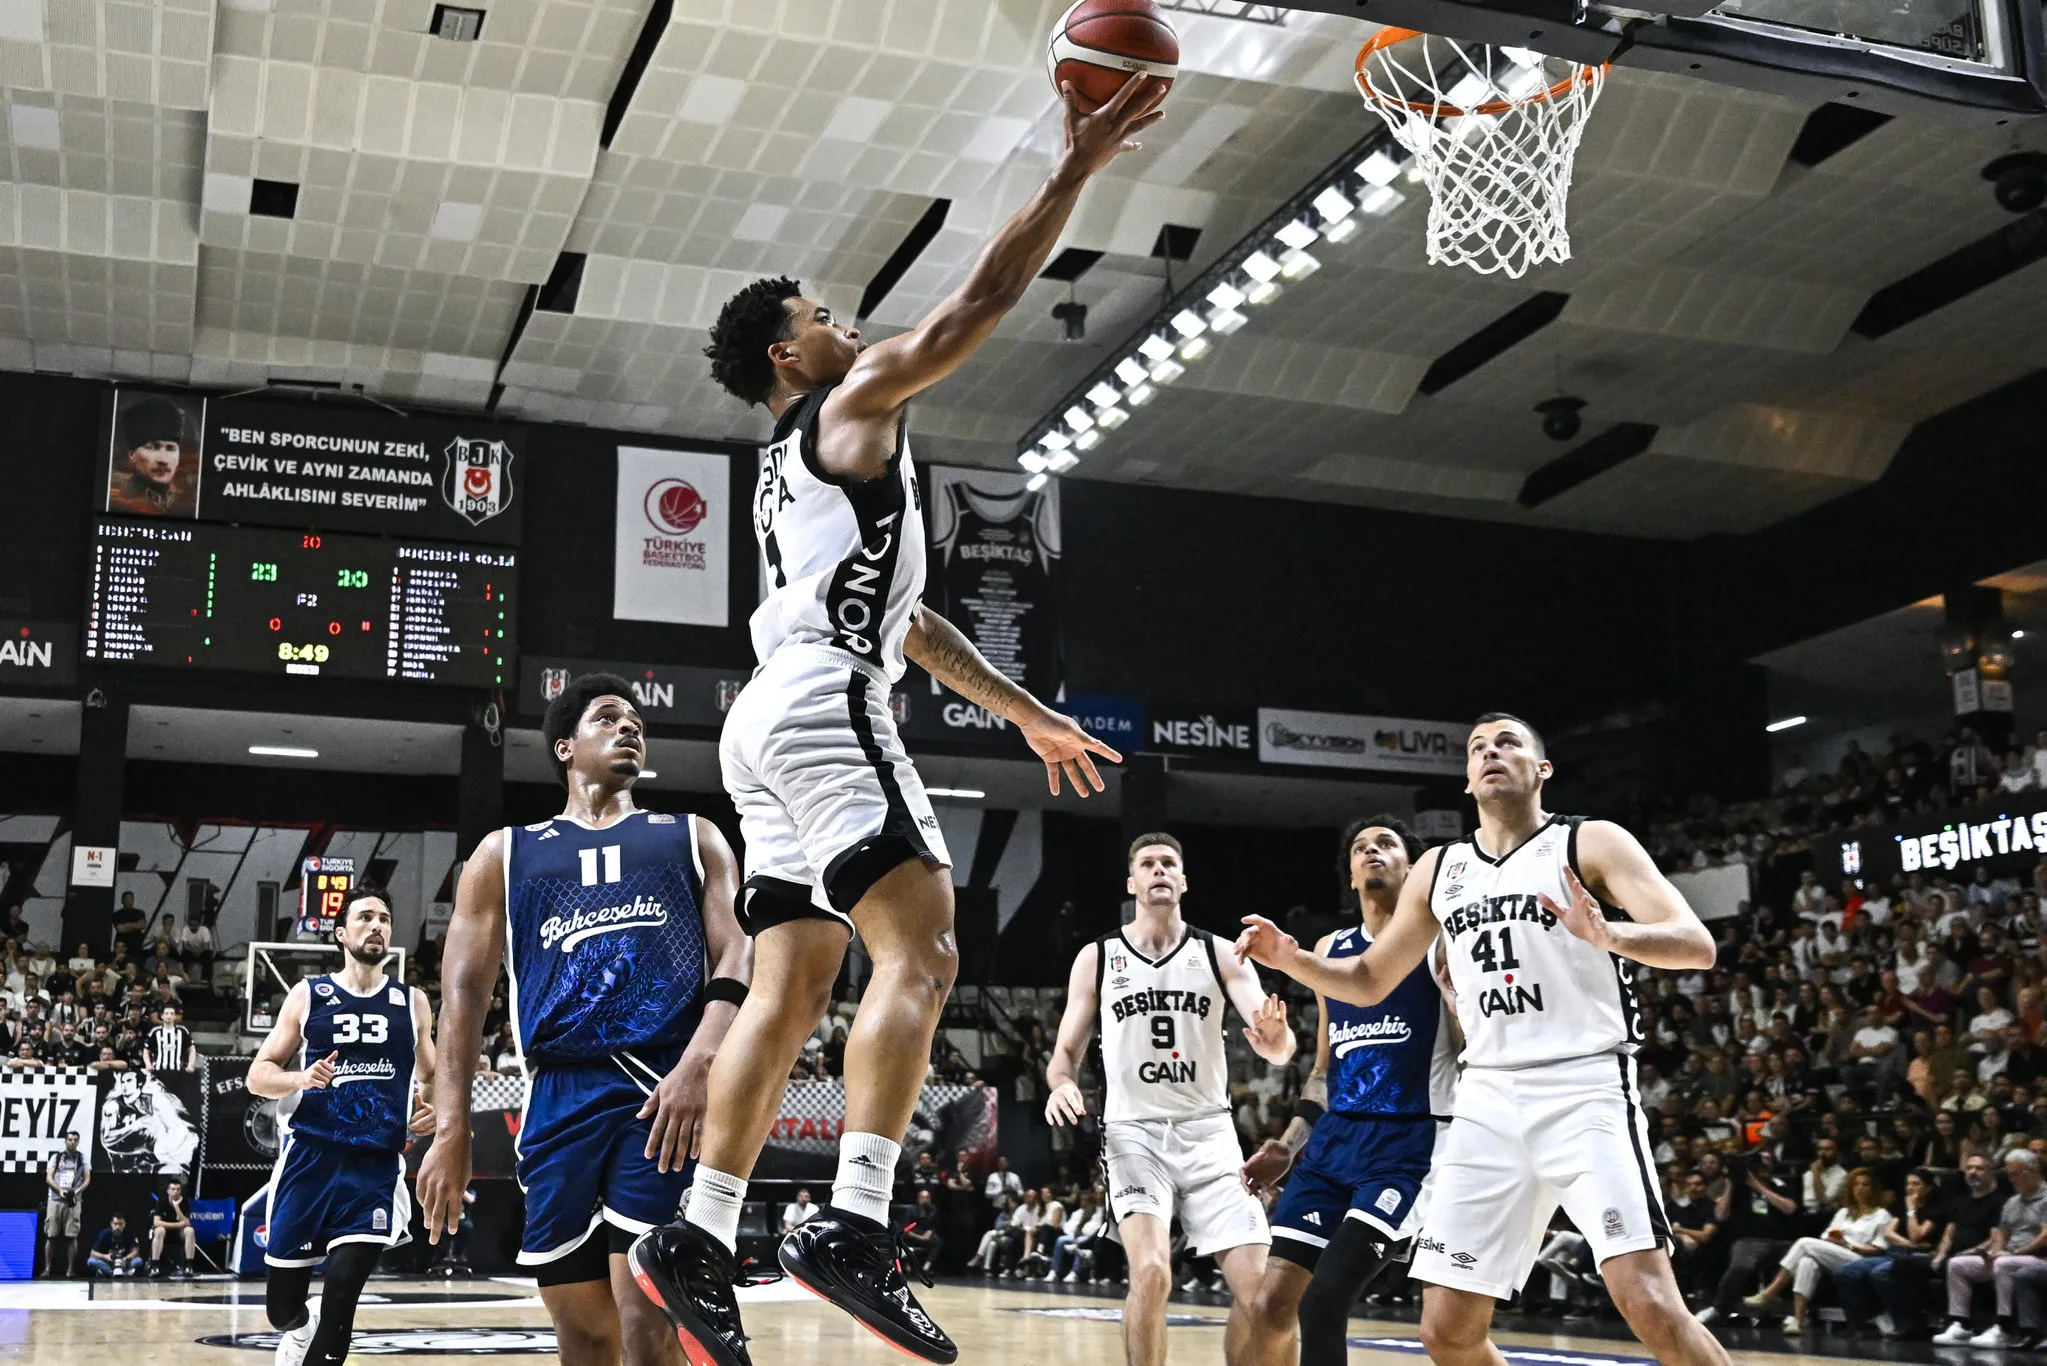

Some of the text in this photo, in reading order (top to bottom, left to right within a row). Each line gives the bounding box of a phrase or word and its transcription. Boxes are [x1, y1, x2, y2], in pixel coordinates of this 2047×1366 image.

[221, 428, 430, 462] "BEN SPORCUNUN ZEKİ,
[214, 454, 434, 488] ÇEVİK VE AYNI ZAMANDA
[222, 481, 336, 504] AHLÂKLISINI
[458, 499, 497, 513] 1903
[643, 536, 706, 554] TÜRKİYE
[643, 550, 705, 563] BASKETBOL
[279, 642, 330, 663] 8:49
[578, 845, 621, 887] 11
[321, 892, 344, 916] 19
[1444, 894, 1557, 943] BEŞİKTAŞ
[540, 895, 667, 951] Bahçeşehir
[1471, 926, 1520, 973] 41
[1111, 987, 1212, 1022] BEŞİKTAŞ
[333, 1014, 389, 1043] 33
[1151, 1016, 1176, 1049] 9
[332, 1058, 395, 1079] ahçeşehir
[0, 1092, 81, 1139] EYİZ
[1418, 1237, 1446, 1254] ESİNE
